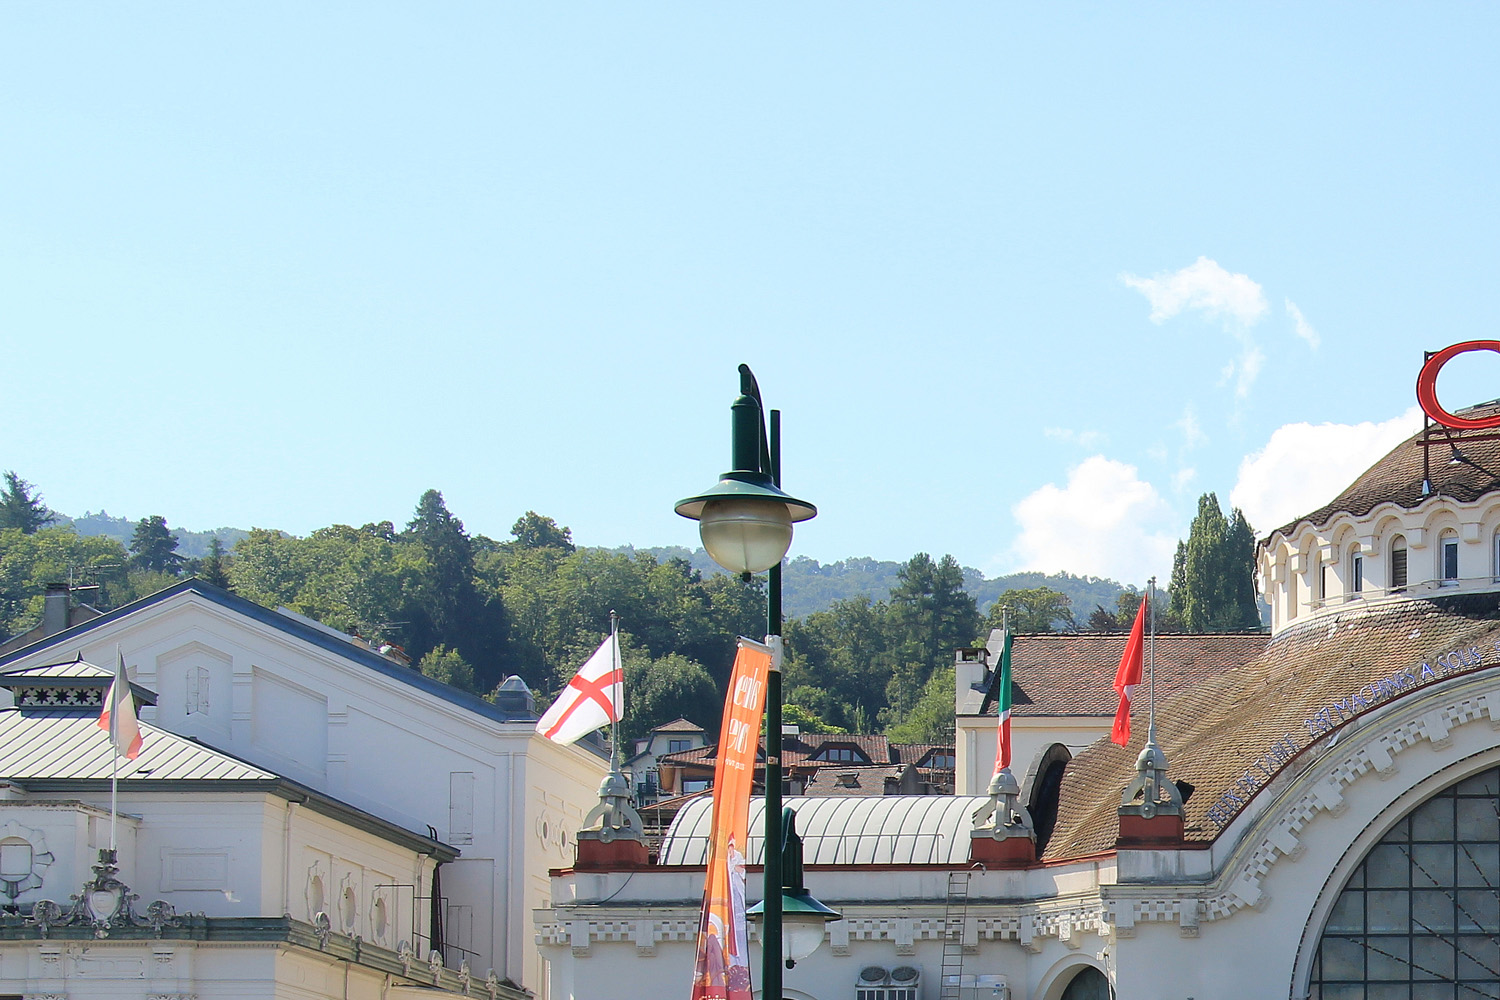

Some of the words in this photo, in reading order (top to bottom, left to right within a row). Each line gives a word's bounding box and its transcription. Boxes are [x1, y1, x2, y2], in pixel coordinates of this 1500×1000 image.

[1303, 706, 1333, 735] 287
[1333, 668, 1415, 716] MACHINES
[1422, 663, 1435, 680] A
[1438, 646, 1481, 672] SOUS
